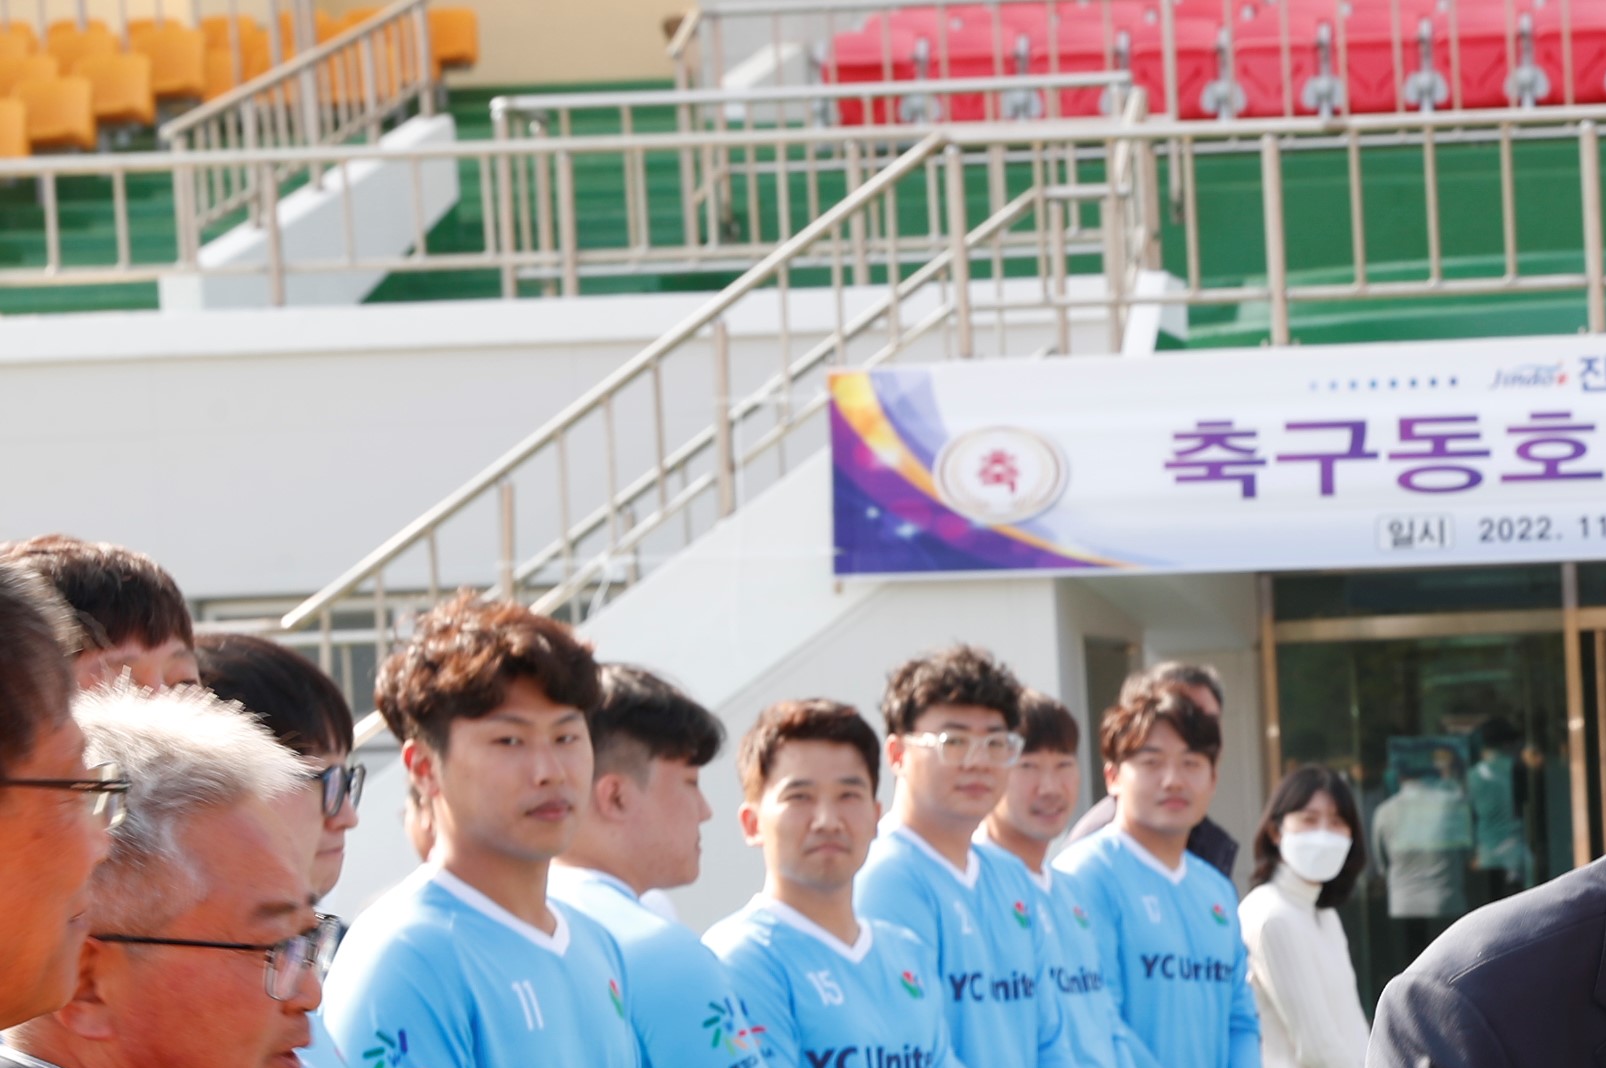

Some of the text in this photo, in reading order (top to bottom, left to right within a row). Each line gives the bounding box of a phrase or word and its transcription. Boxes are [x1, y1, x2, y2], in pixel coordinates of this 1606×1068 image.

[1387, 517, 1446, 549] 일시
[1478, 516, 1563, 544] 2022.
[1140, 954, 1176, 980] YC
[805, 970, 844, 1007] 15
[949, 971, 983, 1002] YC
[511, 979, 545, 1031] 11
